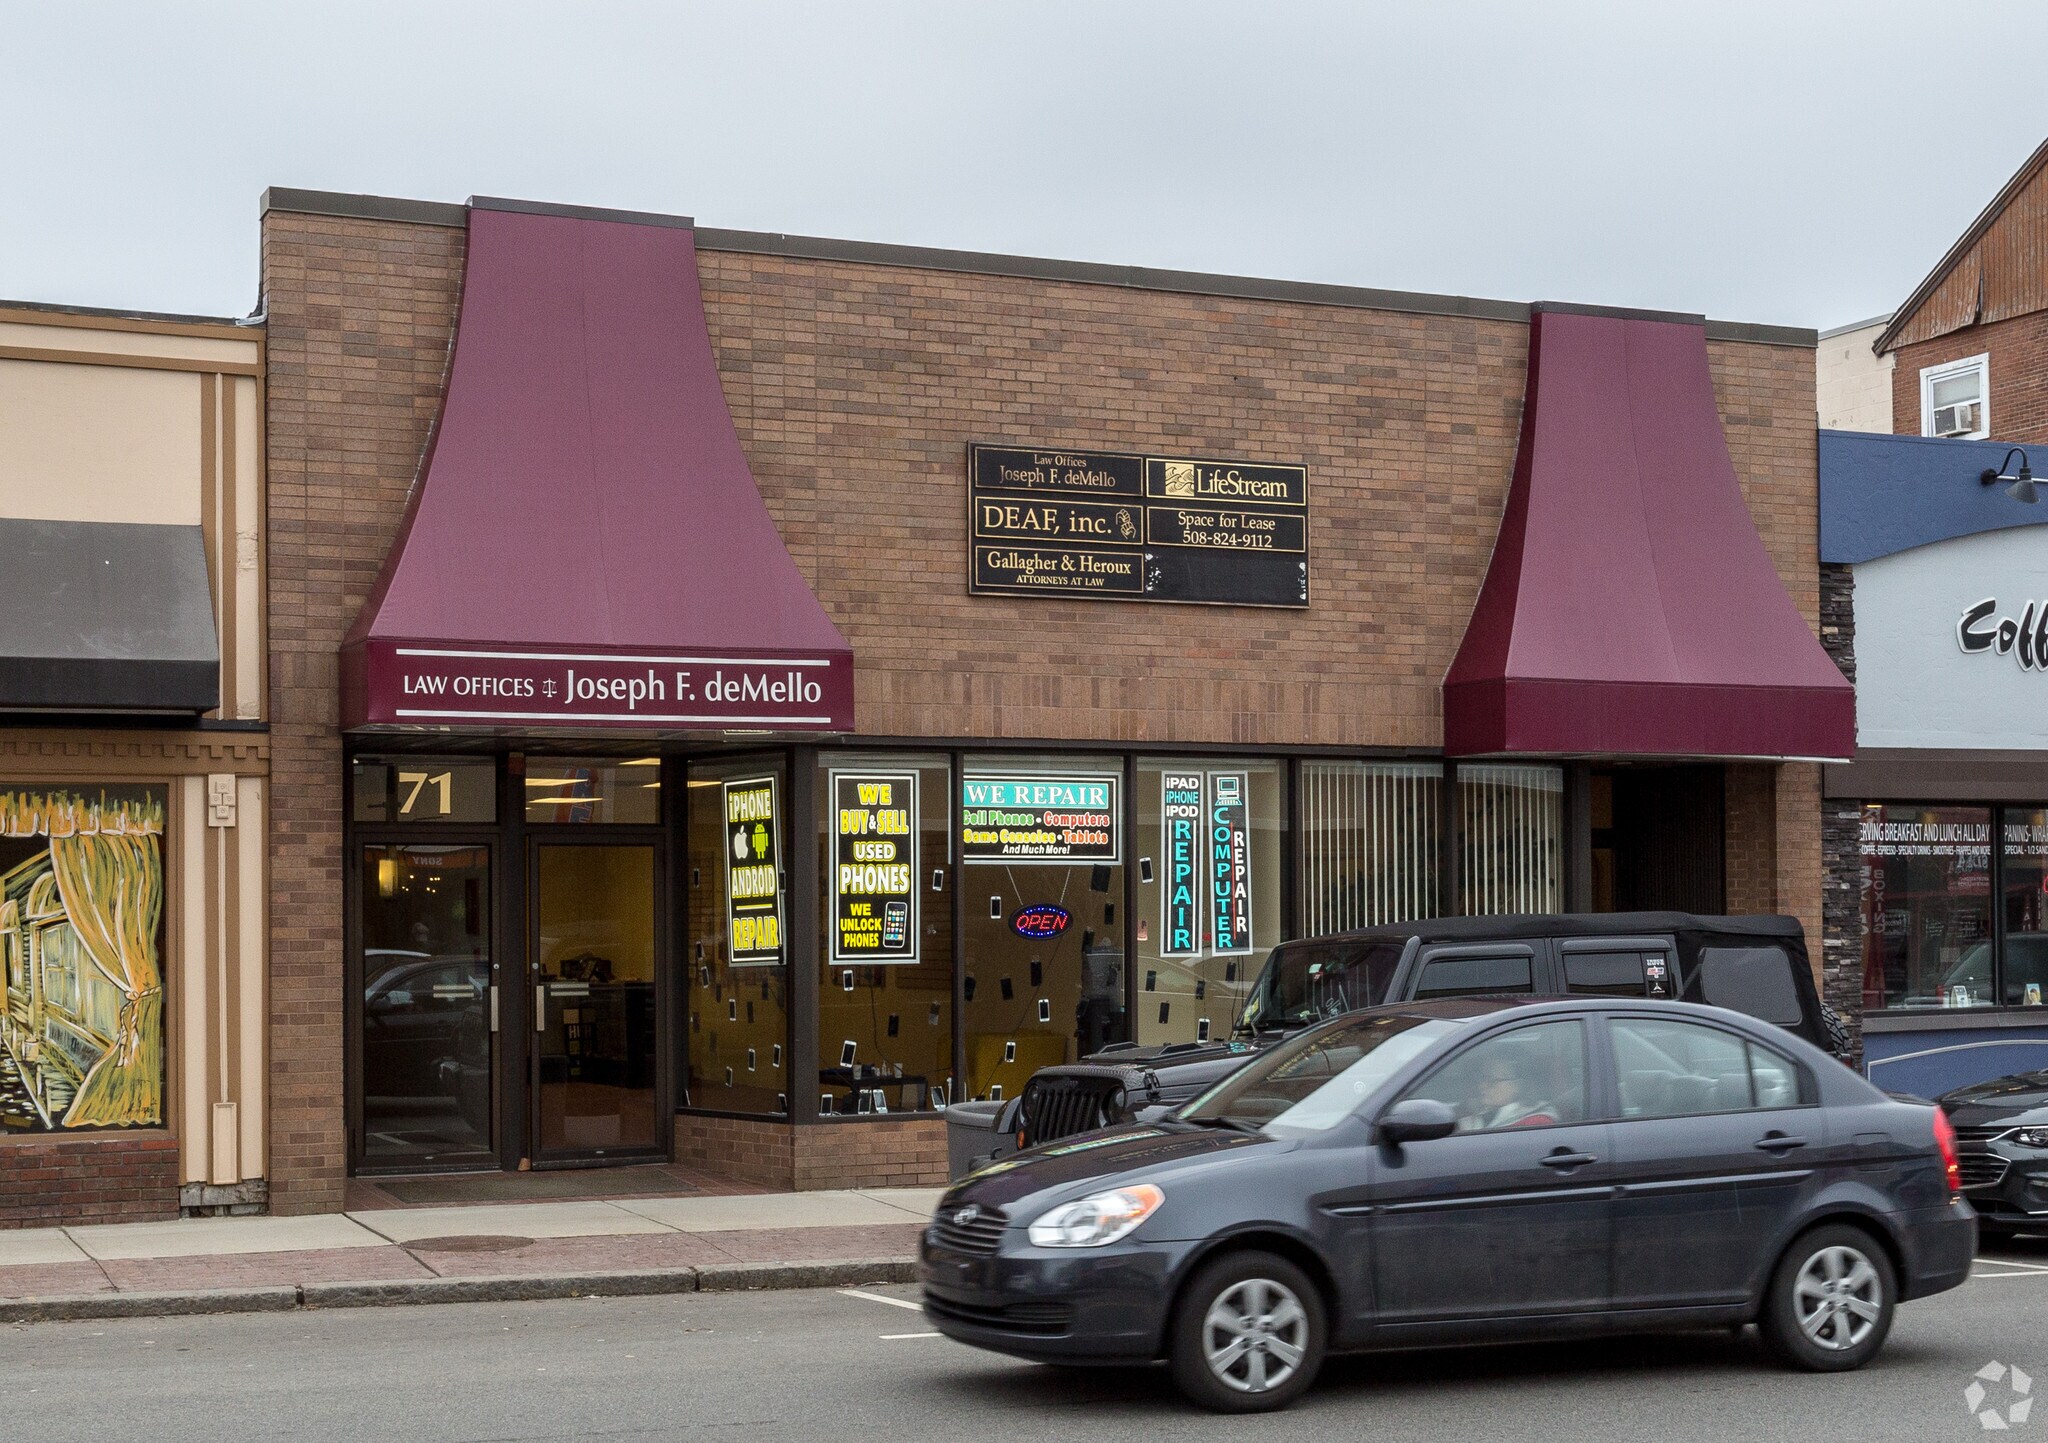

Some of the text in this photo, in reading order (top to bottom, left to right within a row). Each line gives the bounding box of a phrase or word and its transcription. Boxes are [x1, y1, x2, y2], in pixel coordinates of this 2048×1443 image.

[1034, 454, 1087, 468] Law Offices
[999, 465, 1116, 488] Joseph F. deMello
[1197, 469, 1288, 498] LifeStream
[984, 505, 1112, 535] DEAF, inc.
[1178, 511, 1276, 530] Space for Lease
[1182, 530, 1273, 548] 508-824-9112
[987, 552, 1132, 575] Gallagher & Heroux
[1016, 574, 1105, 588] ATTORNEYS AT LAW
[404, 669, 822, 710] LAW OFFICES Joseph F. deMello
[398, 772, 452, 814] 71
[1166, 777, 1200, 790] iPAD
[858, 784, 892, 806] WE
[966, 785, 1106, 806] WE REPAIR
[1166, 791, 1199, 804] iPHONE
[729, 789, 772, 823] iPHONE
[1166, 805, 1199, 818] iPOD
[840, 809, 910, 835] BUY & SELL
[963, 809, 1110, 830] Cell Phones Computers
[963, 828, 1109, 845] Game Consoles Tablets
[1884, 822, 1923, 842] BREAKFAST
[1923, 823, 1939, 842] AND
[1939, 824, 1962, 842] LUNCH
[1963, 824, 1976, 842] ALL
[1976, 824, 1991, 842] DAY
[853, 841, 897, 862] USED
[1002, 844, 1071, 855] And Much More!
[2004, 845, 2025, 855] SPECIAL
[732, 864, 776, 899] ANDROID
[840, 864, 910, 895] PHONES
[1172, 820, 1192, 950] REPAIR
[1213, 807, 1232, 948] COMPUTER
[1234, 831, 1248, 933] REPAIR
[850, 904, 872, 916] WE
[840, 918, 882, 932] UNLOCK
[1016, 914, 1068, 931] OPEN
[732, 916, 780, 952] REPAIR
[844, 932, 880, 948] PHONES
